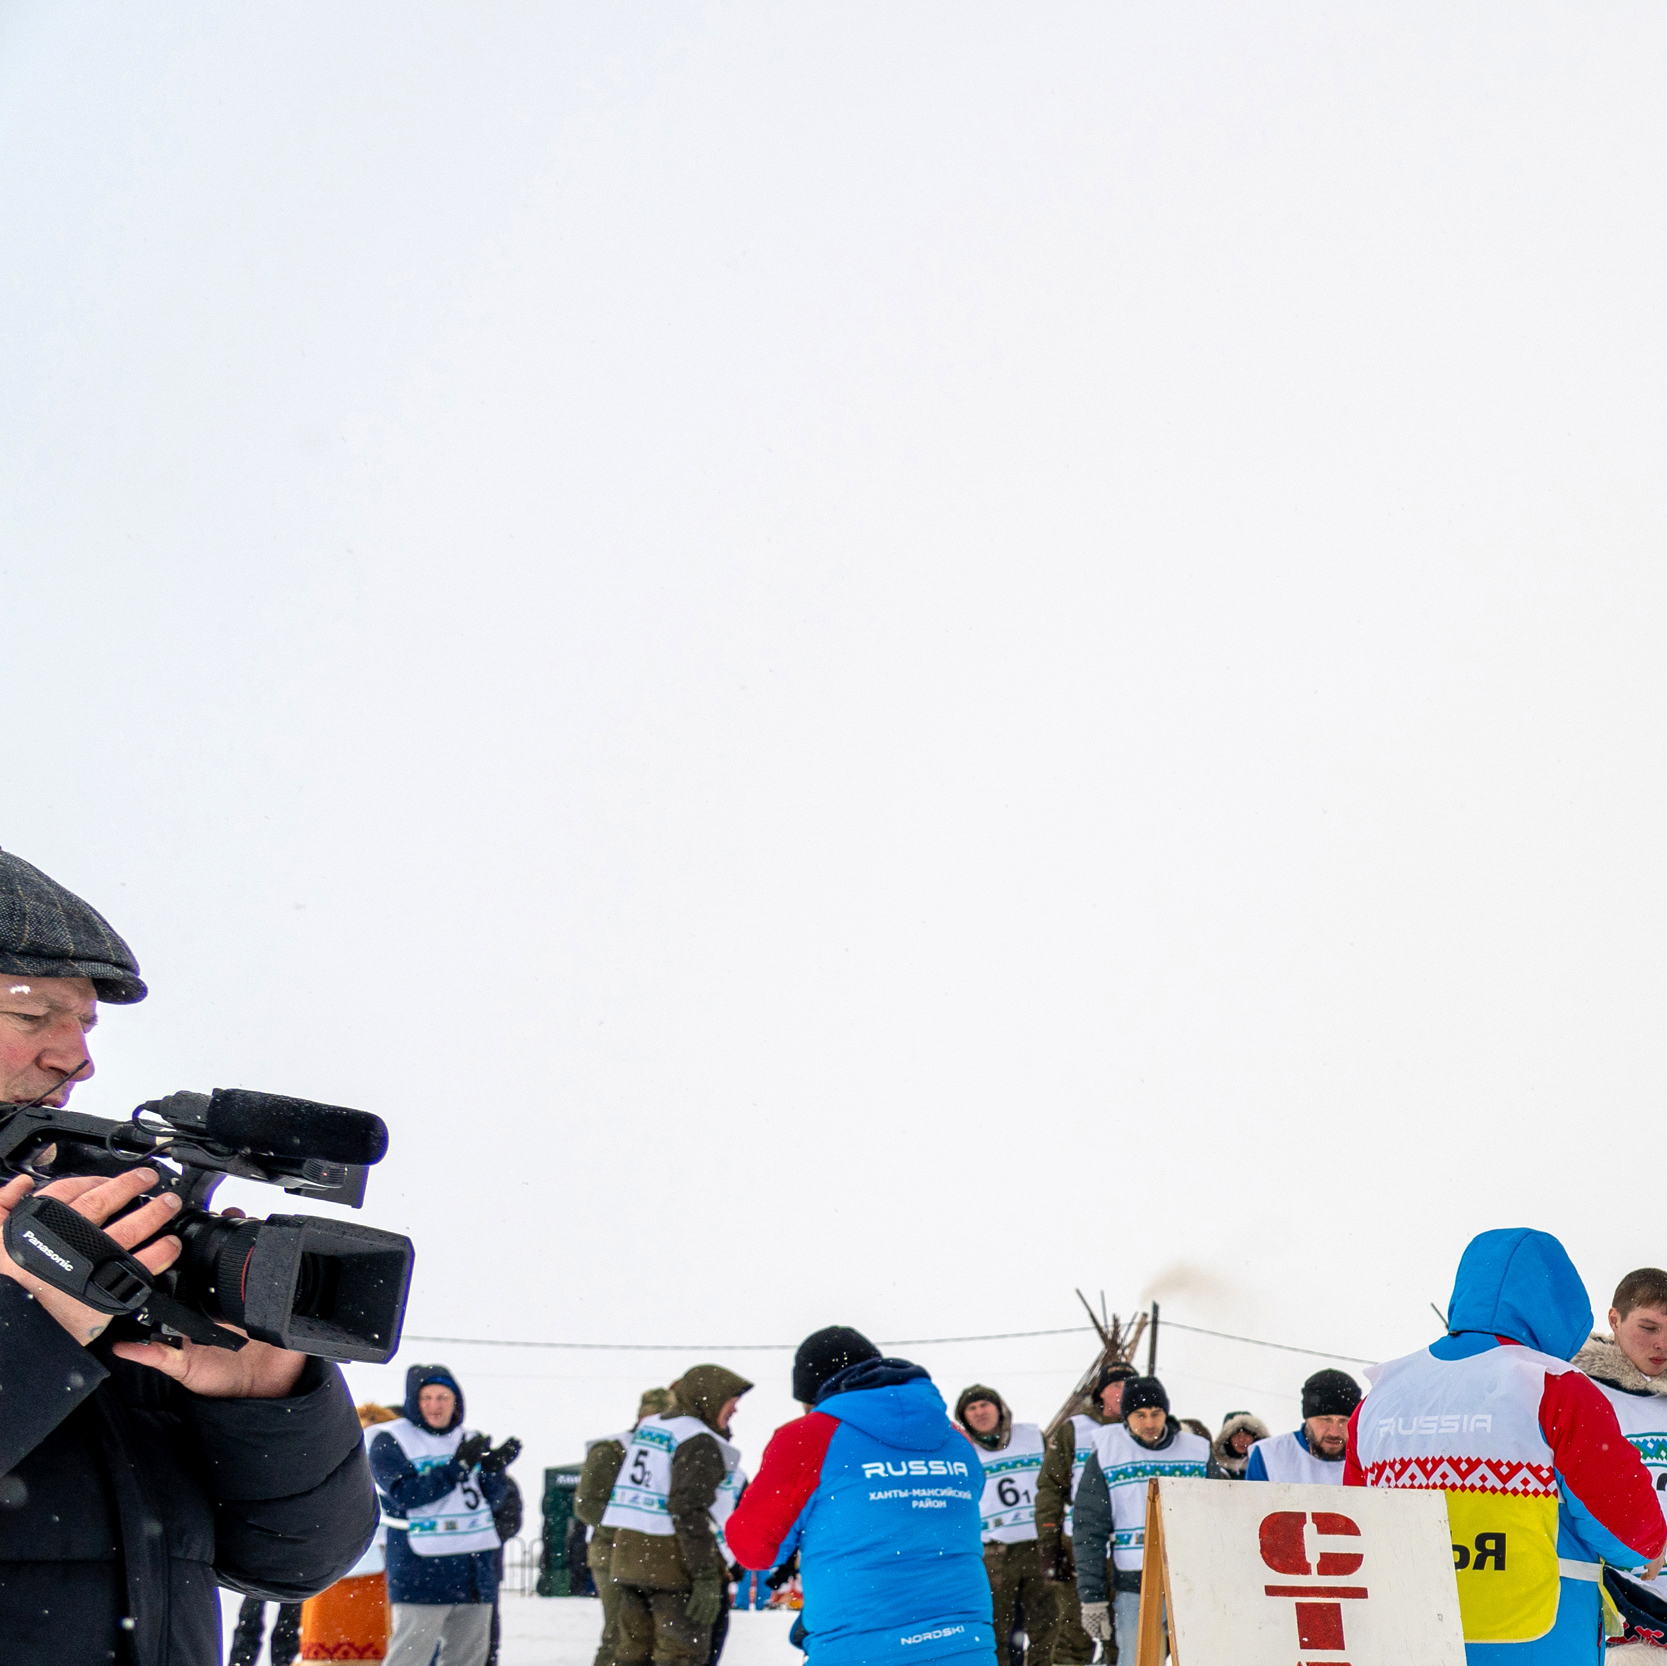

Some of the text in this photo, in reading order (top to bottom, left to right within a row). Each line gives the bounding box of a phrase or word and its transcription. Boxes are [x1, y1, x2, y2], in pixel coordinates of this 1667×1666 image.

[23, 1230, 74, 1272] Panasonic
[1378, 1414, 1493, 1437] RUSSIA
[862, 1460, 968, 1478] RUSSIA
[868, 1486, 972, 1501] ХАНТЫ-МАНСИЙСКИЙ
[998, 1477, 1020, 1507] 6
[911, 1497, 947, 1509] РАЙОН
[901, 1625, 965, 1645] NORDSKI
